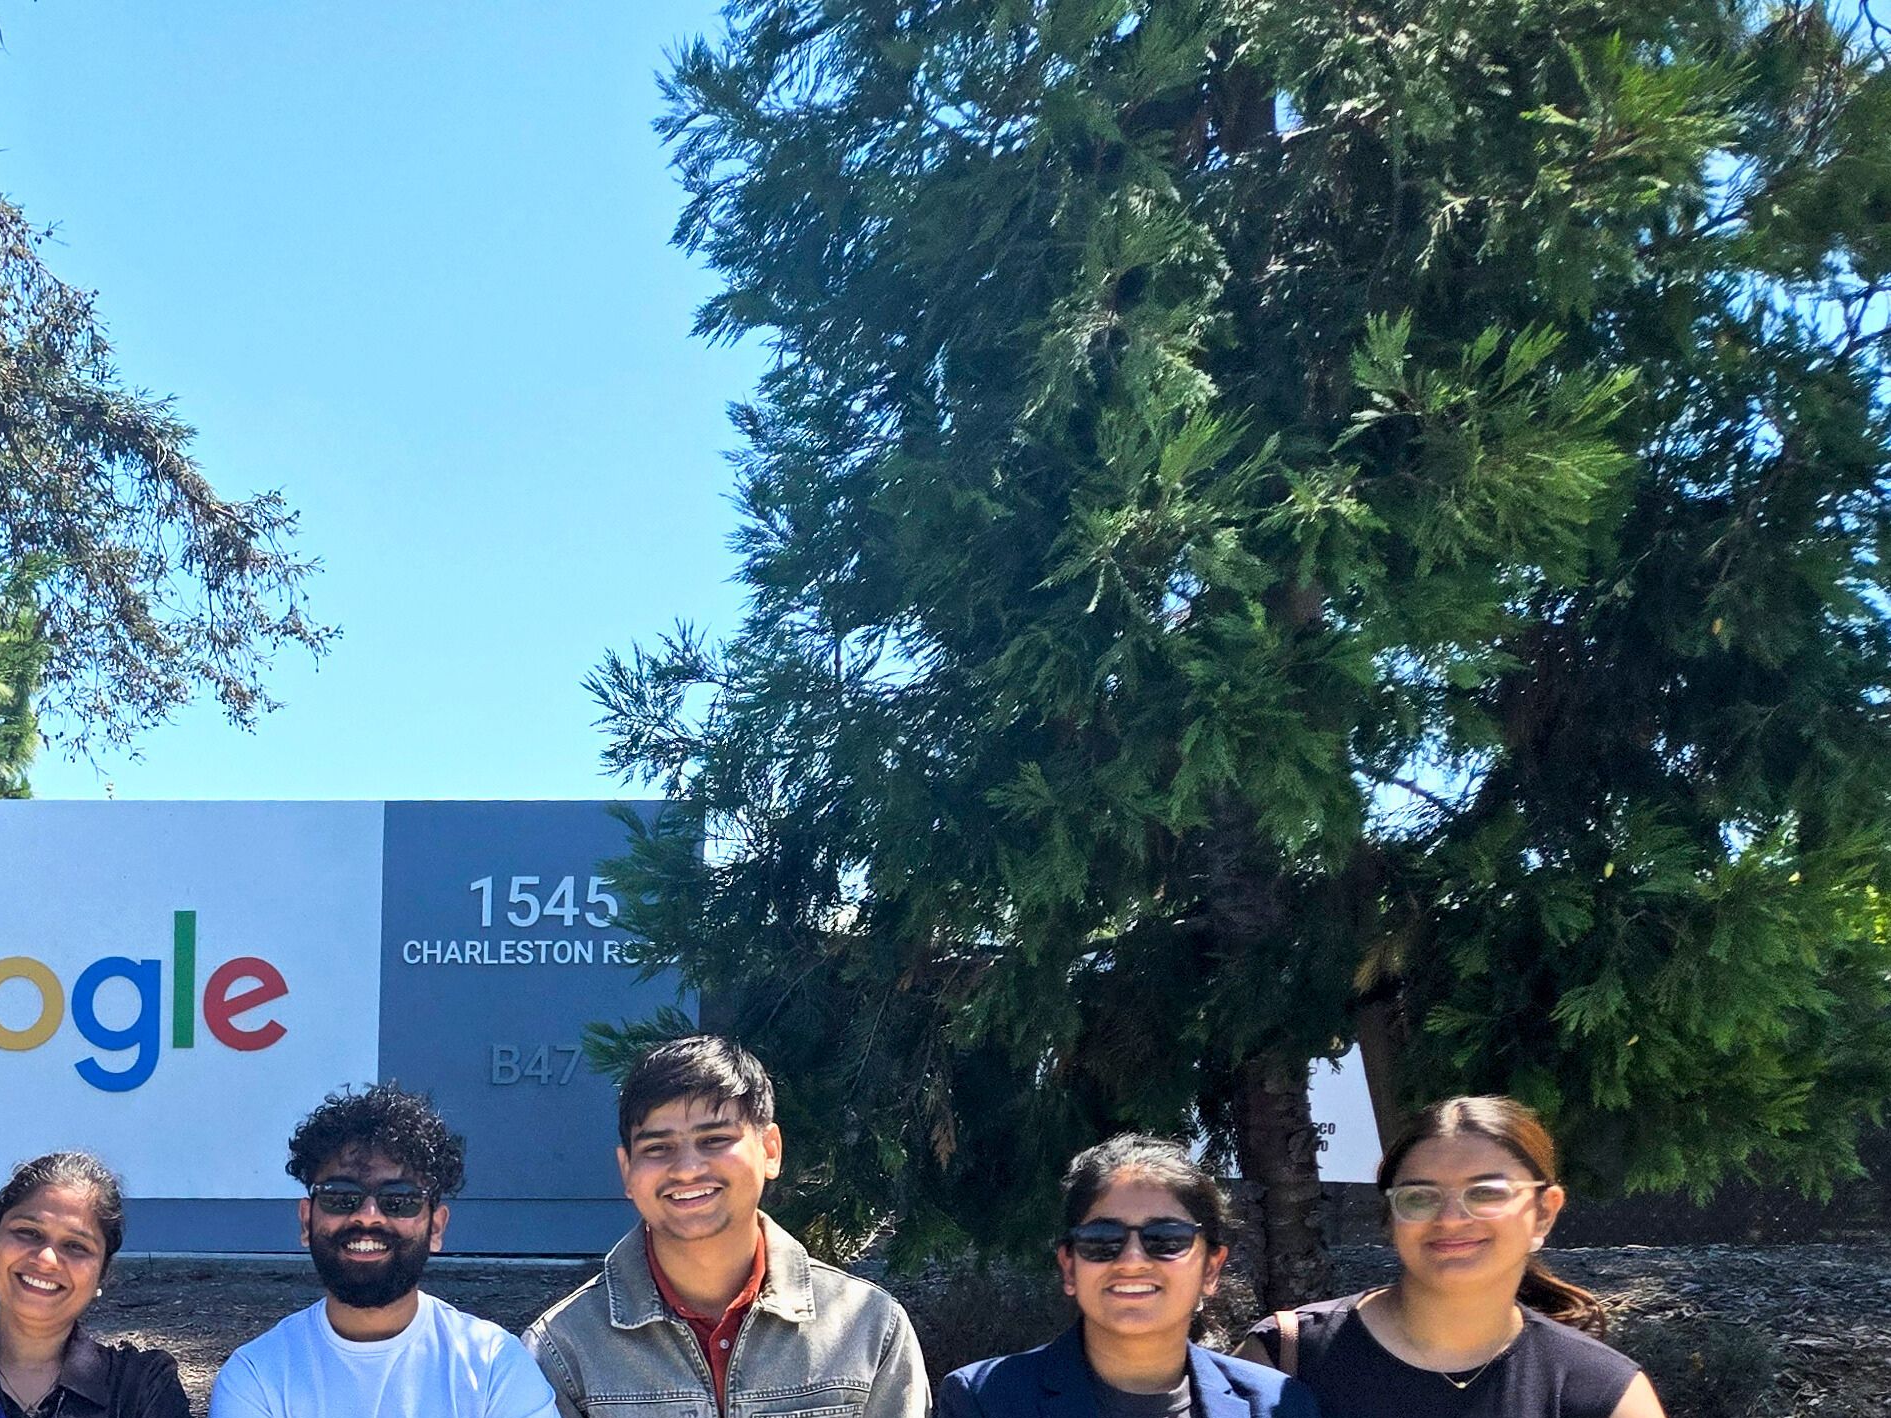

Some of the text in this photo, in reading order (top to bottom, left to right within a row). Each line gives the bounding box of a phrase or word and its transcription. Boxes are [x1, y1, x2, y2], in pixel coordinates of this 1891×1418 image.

[469, 875, 619, 928] 1545
[402, 939, 594, 965] CHARLESTON
[489, 1043, 583, 1086] B47
